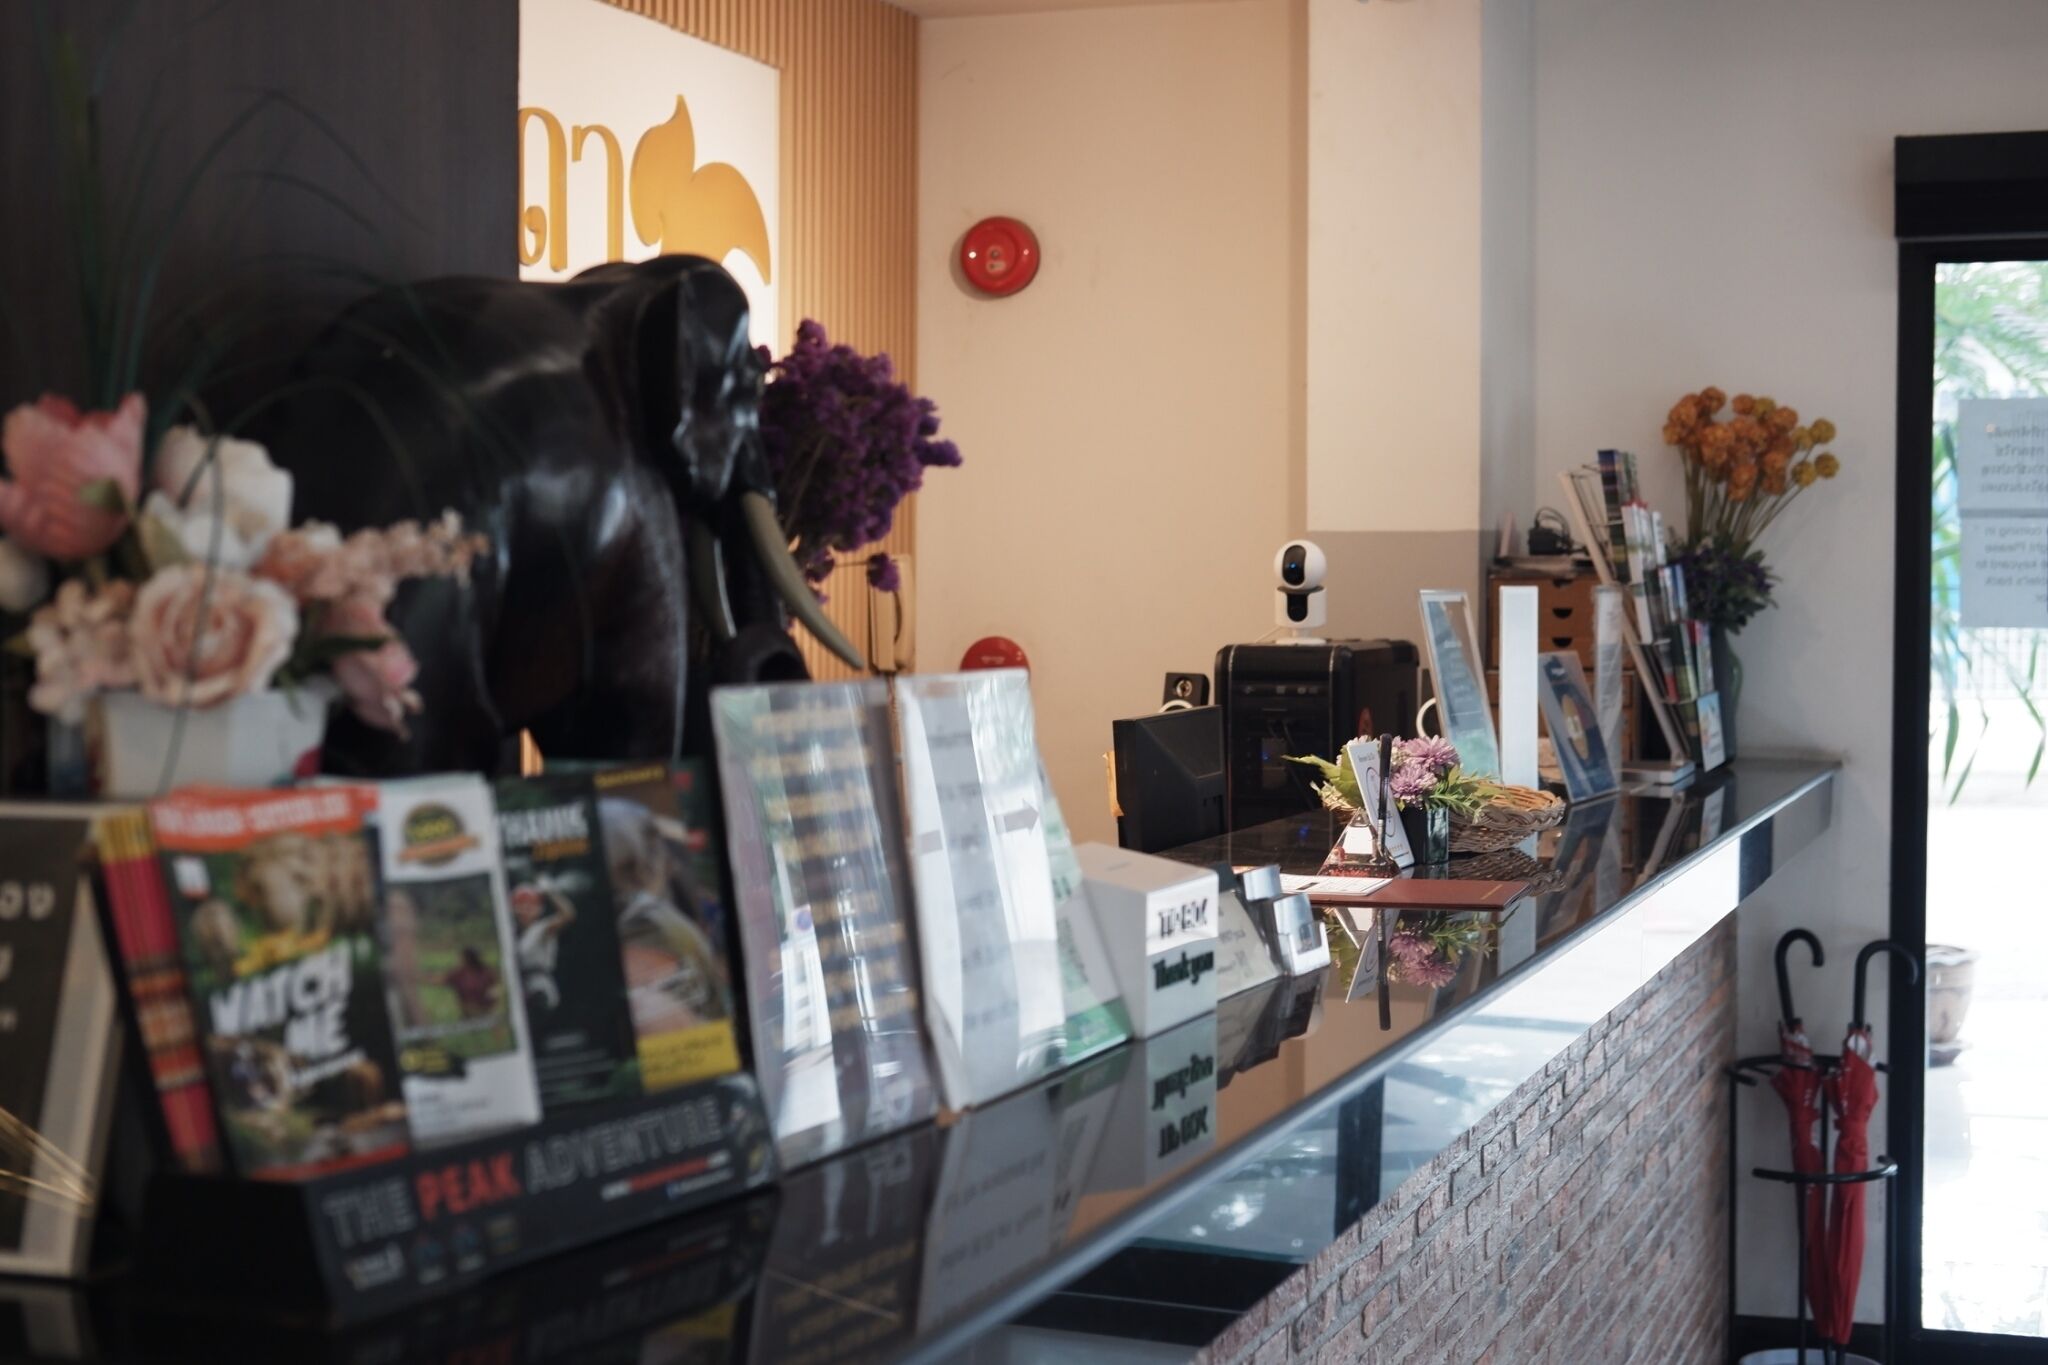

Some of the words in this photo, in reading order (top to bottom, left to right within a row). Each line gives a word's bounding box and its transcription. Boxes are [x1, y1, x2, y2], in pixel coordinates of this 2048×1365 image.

[321, 1177, 416, 1249] THE
[415, 1151, 522, 1222] PEAK
[524, 1095, 724, 1194] ADVENTURE
